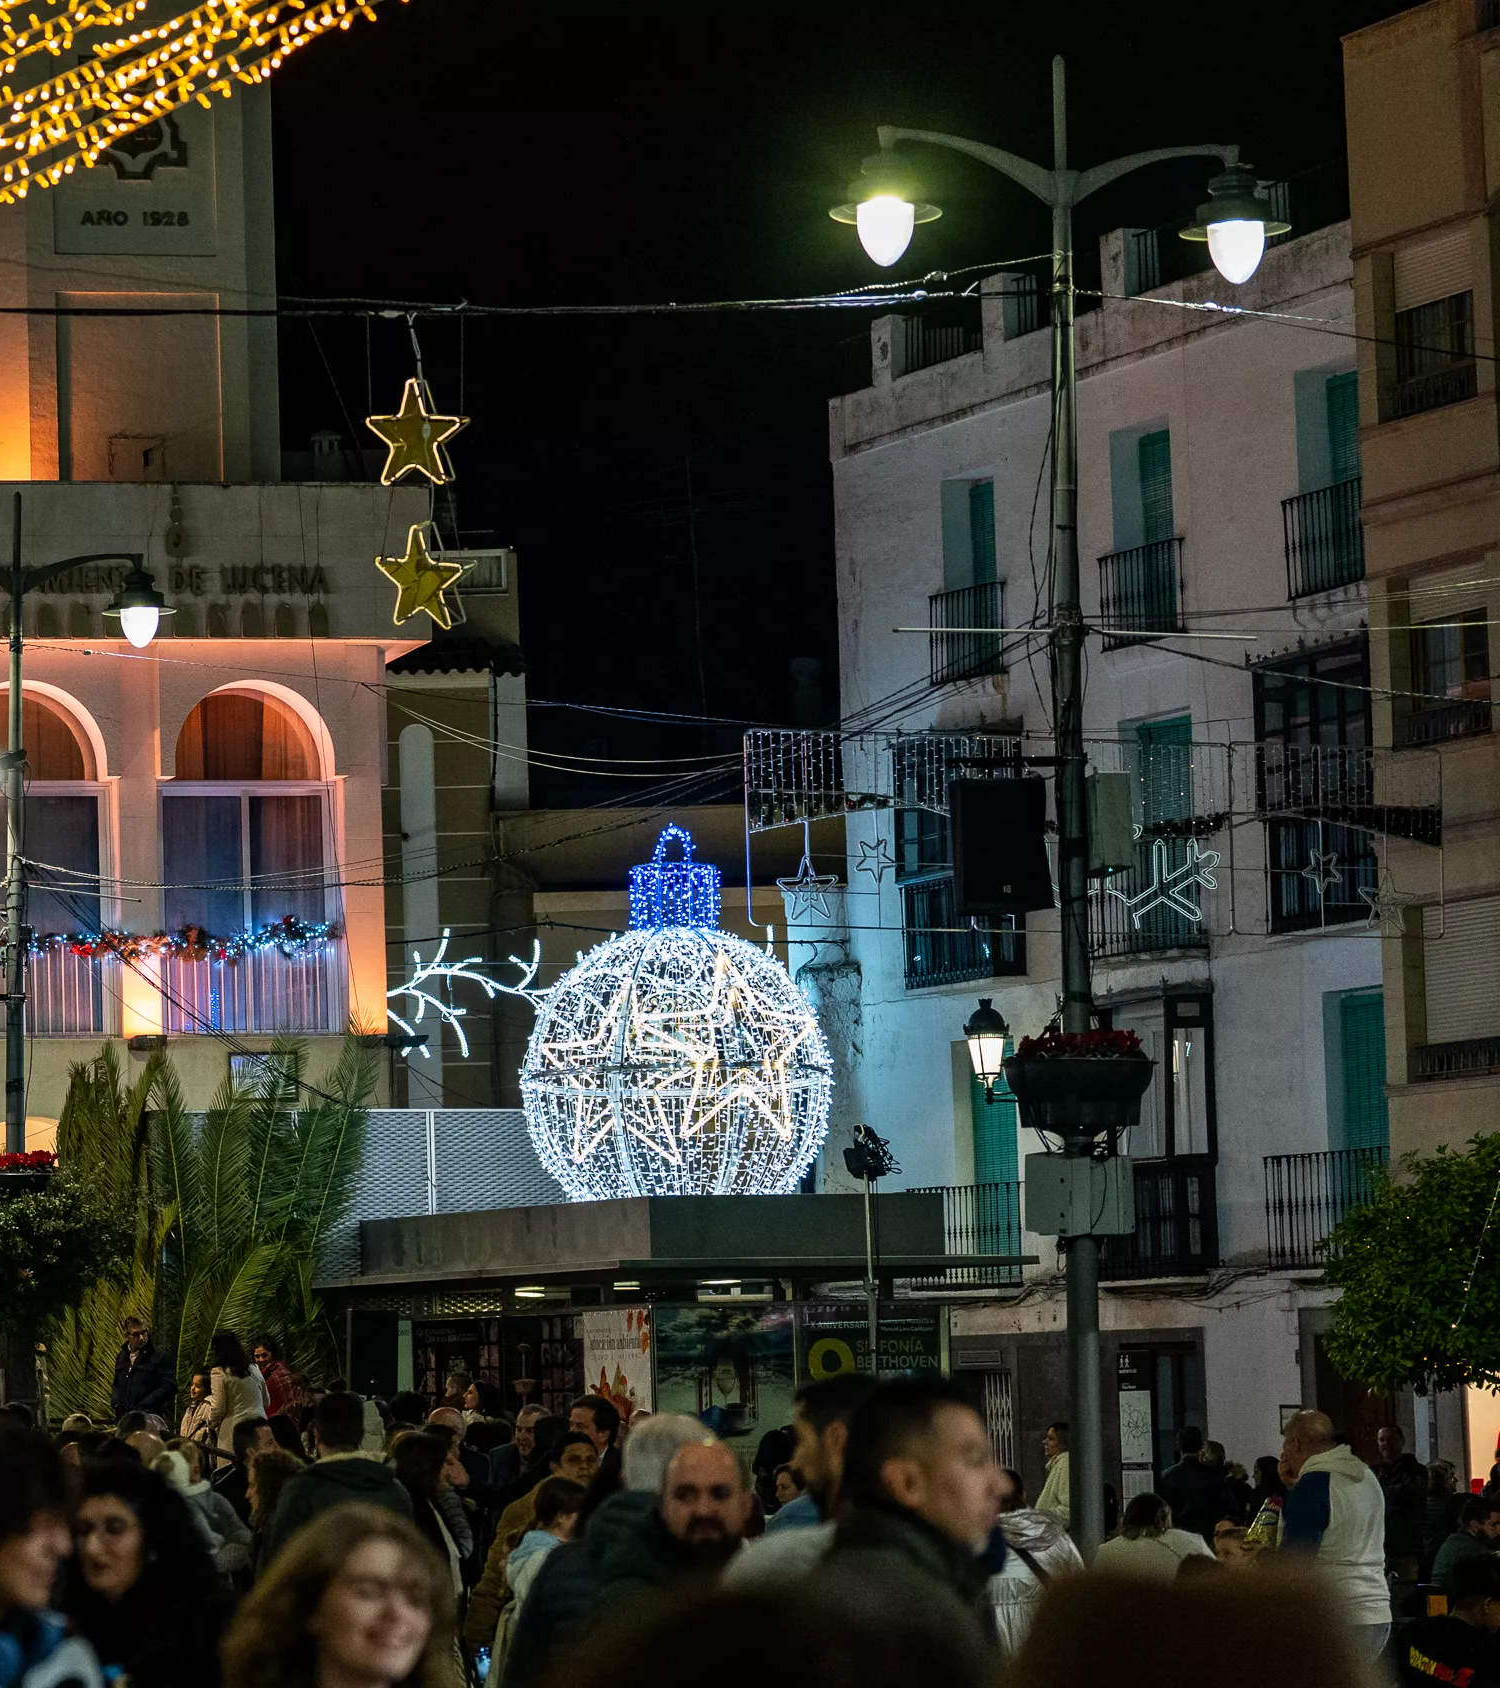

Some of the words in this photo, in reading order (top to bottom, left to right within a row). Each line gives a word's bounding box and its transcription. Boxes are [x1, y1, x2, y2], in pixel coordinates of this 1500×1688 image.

[81, 209, 128, 226] AÑO
[142, 210, 190, 227] 1928
[169, 565, 204, 594] DE
[220, 564, 331, 594] LUCENA
[817, 1320, 869, 1330] ANIVERSARI
[856, 1336, 924, 1353] SIFONÍA
